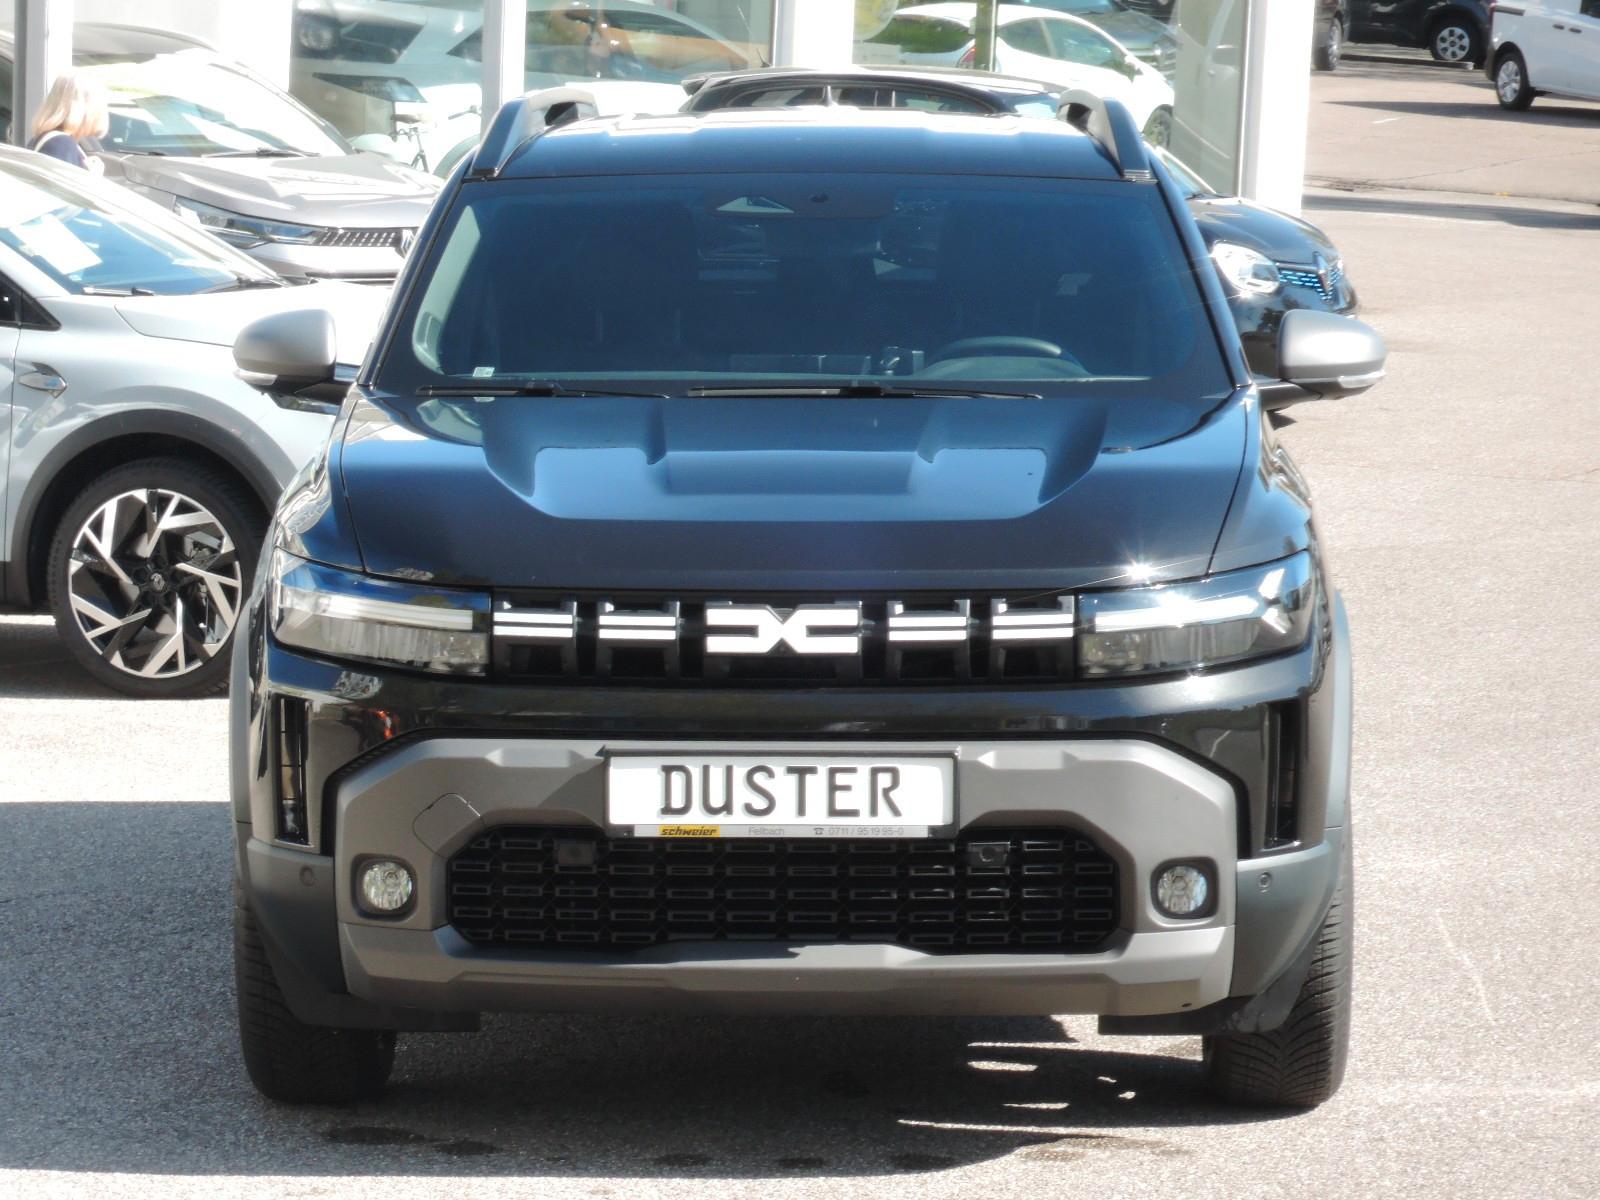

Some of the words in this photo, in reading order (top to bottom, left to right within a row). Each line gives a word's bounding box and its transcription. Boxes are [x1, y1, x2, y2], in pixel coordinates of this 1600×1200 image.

[660, 764, 902, 817] DUSTER
[661, 826, 717, 836] schweier
[748, 826, 785, 836] Fellbach
